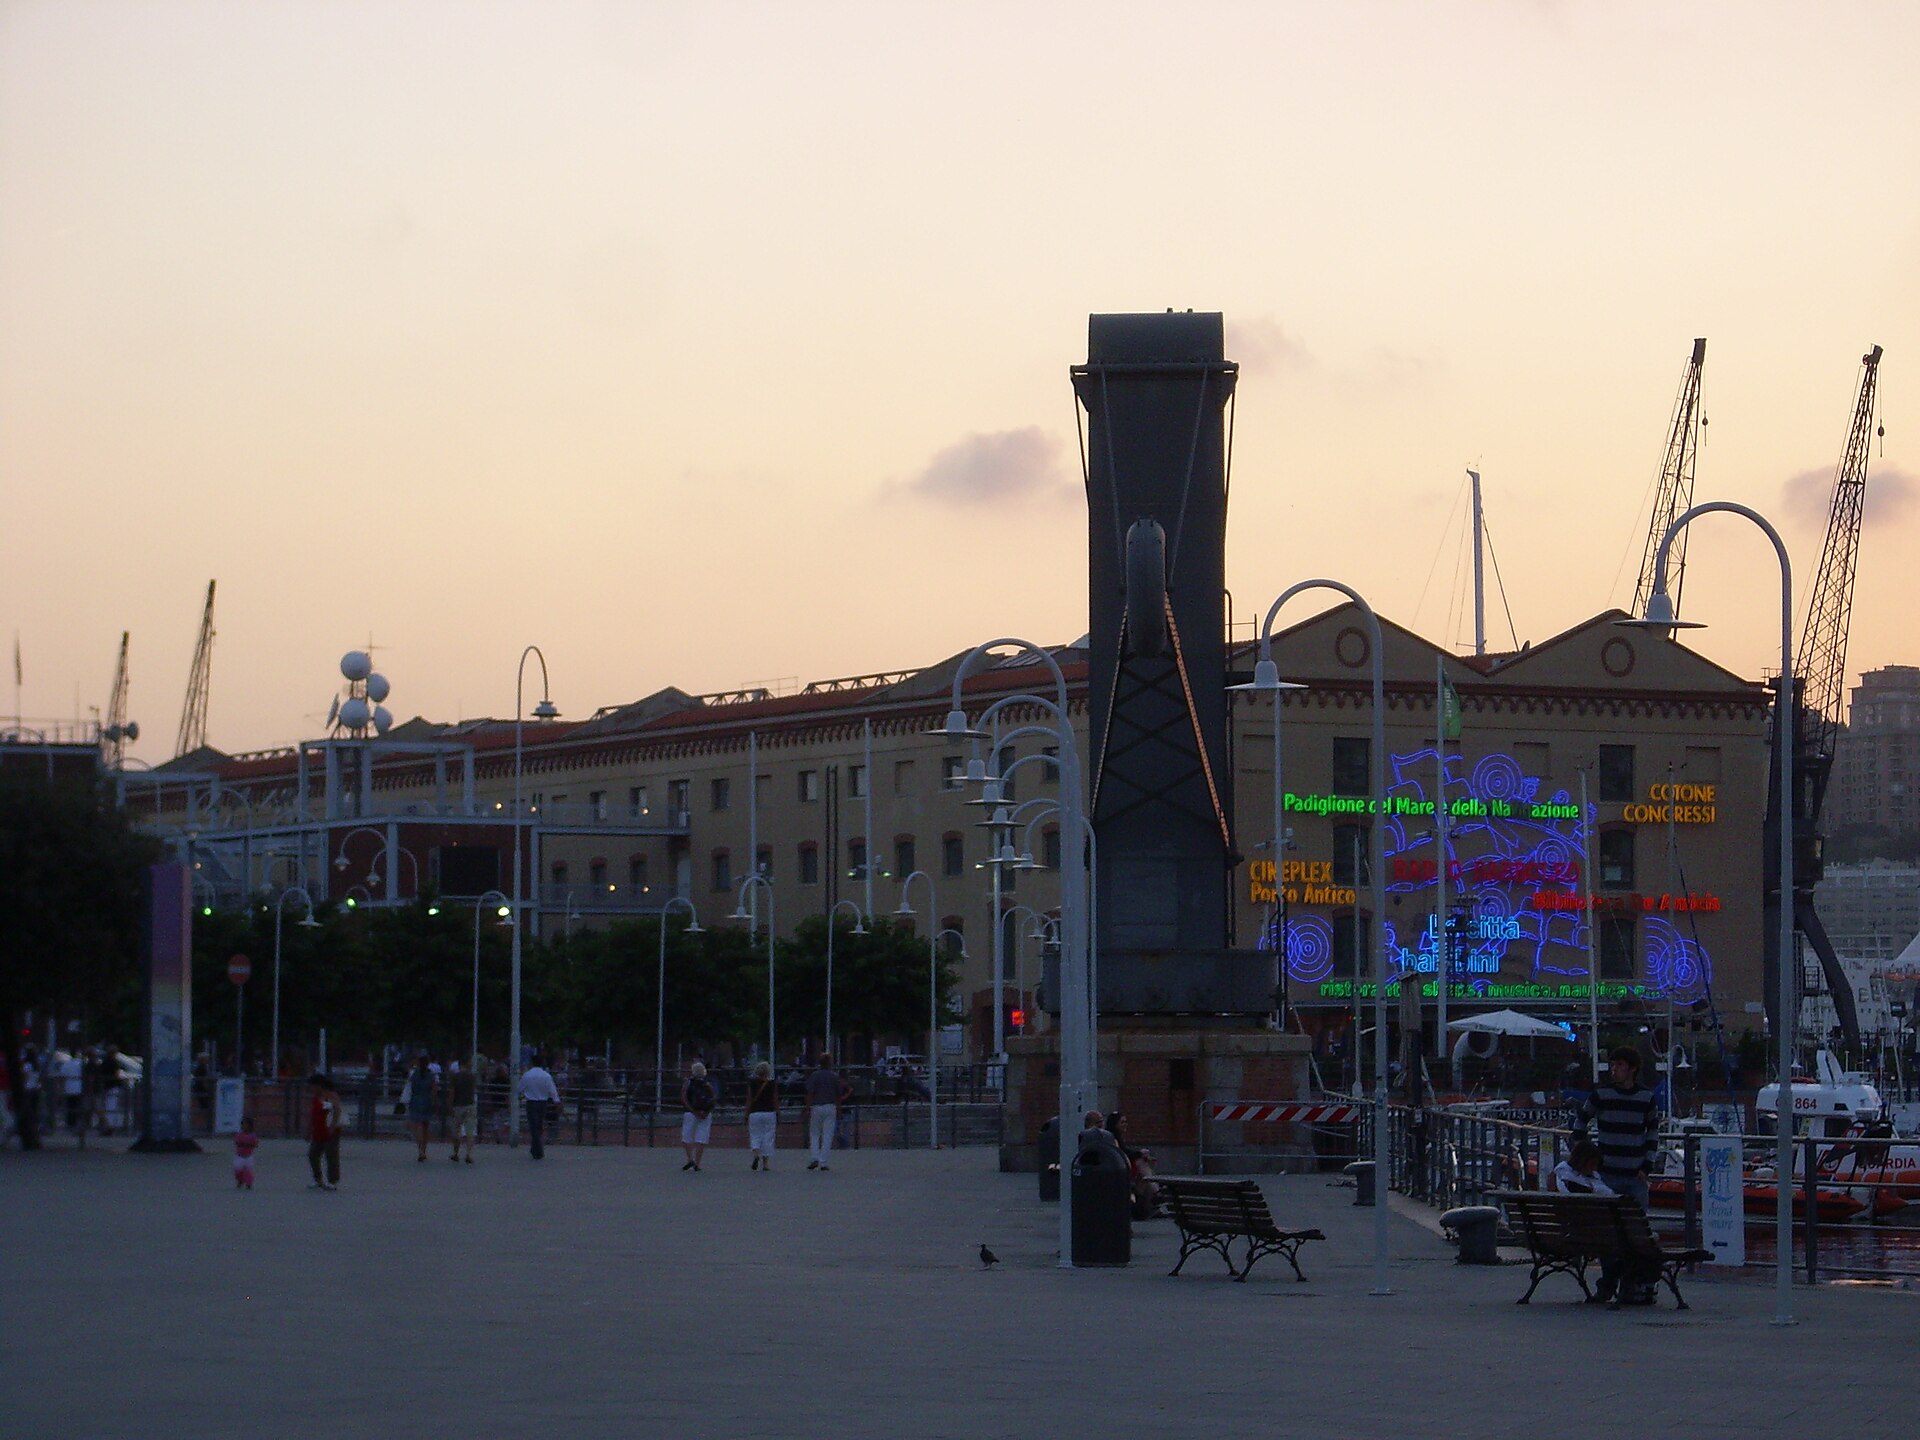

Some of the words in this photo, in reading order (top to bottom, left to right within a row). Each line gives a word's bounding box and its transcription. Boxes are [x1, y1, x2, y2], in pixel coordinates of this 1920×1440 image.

[1649, 783, 1716, 803] COTONE
[1284, 793, 1365, 816] Padiglione
[1396, 797, 1436, 815] Mare
[1451, 799, 1488, 817] della
[1491, 799, 1580, 819] Naazione
[1250, 860, 1333, 883] CINEPLEX
[1393, 858, 1463, 880] RADO
[1303, 883, 1356, 905] Antico
[1401, 947, 1500, 974] babini
[1795, 1097, 1817, 1110] 864
